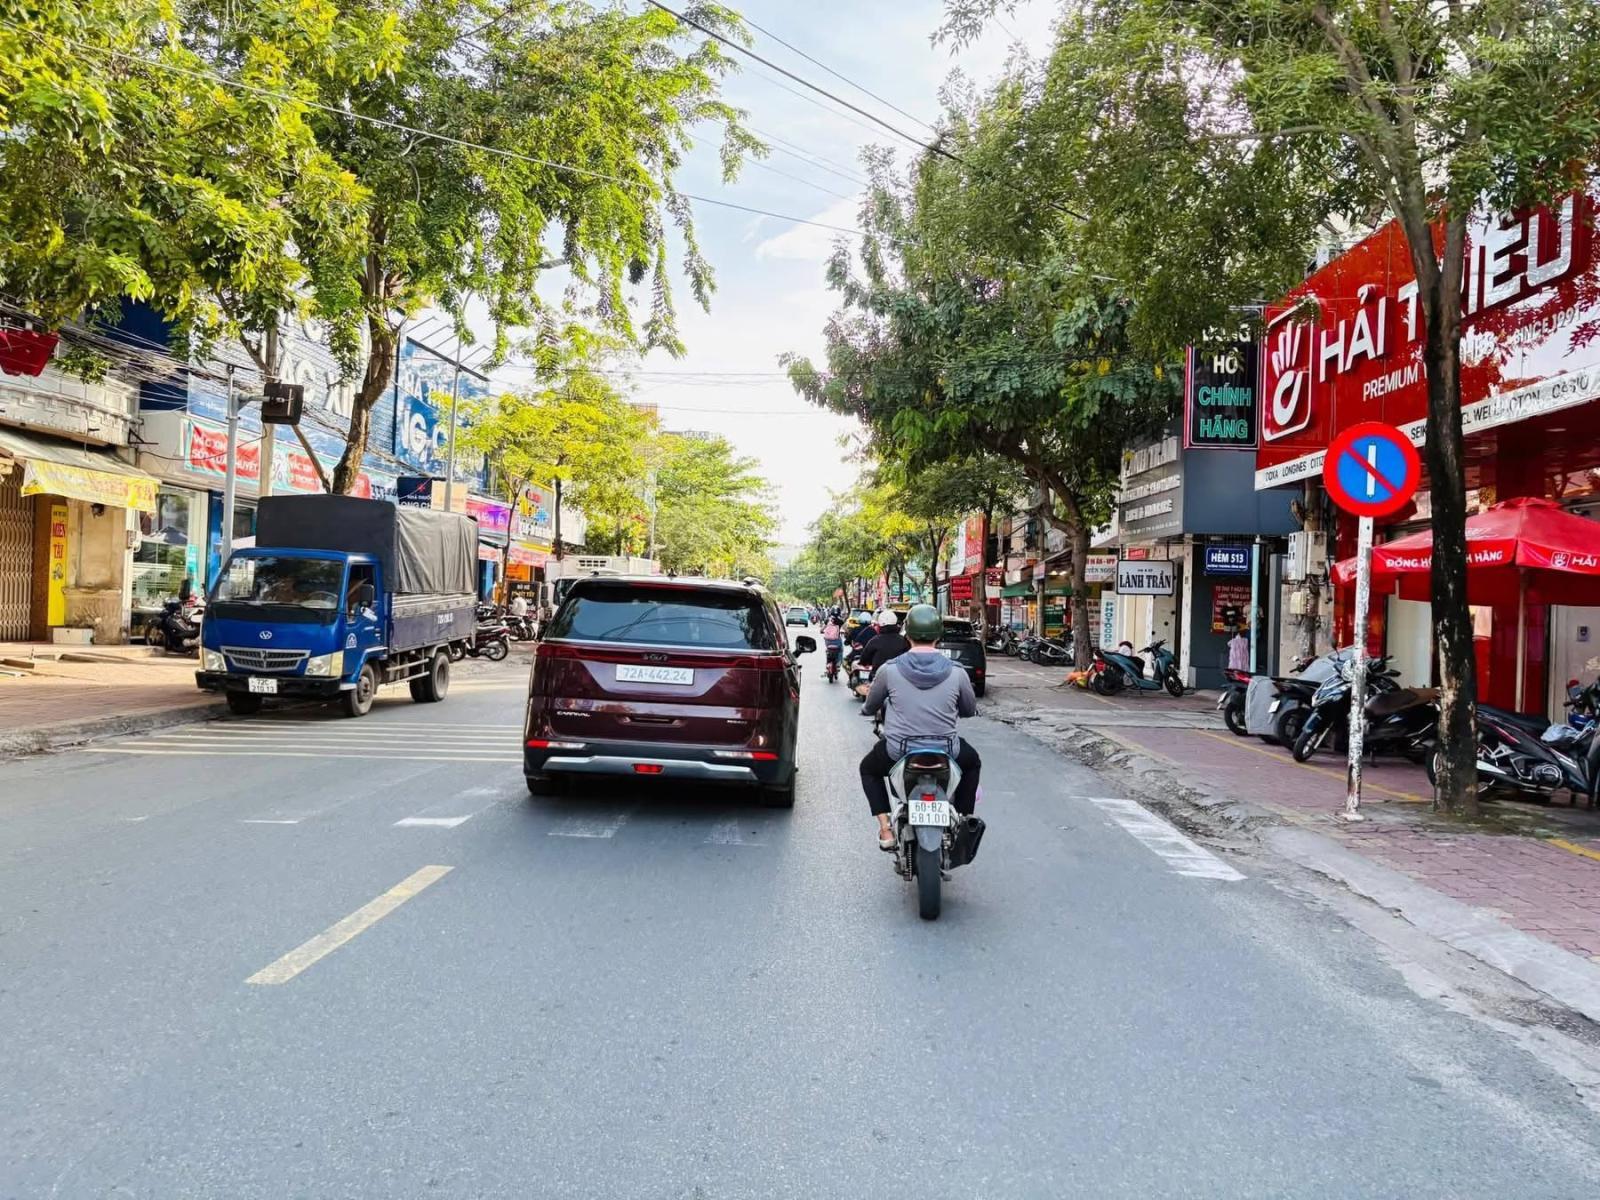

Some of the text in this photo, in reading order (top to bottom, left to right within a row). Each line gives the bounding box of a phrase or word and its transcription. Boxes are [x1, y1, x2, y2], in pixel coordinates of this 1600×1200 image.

[1319, 284, 1387, 383] HẢI
[1362, 363, 1419, 402] PREMIUM
[1198, 383, 1252, 406] CHÍNH
[1231, 553, 1245, 564] 513
[1119, 571, 1144, 589] LÀNH
